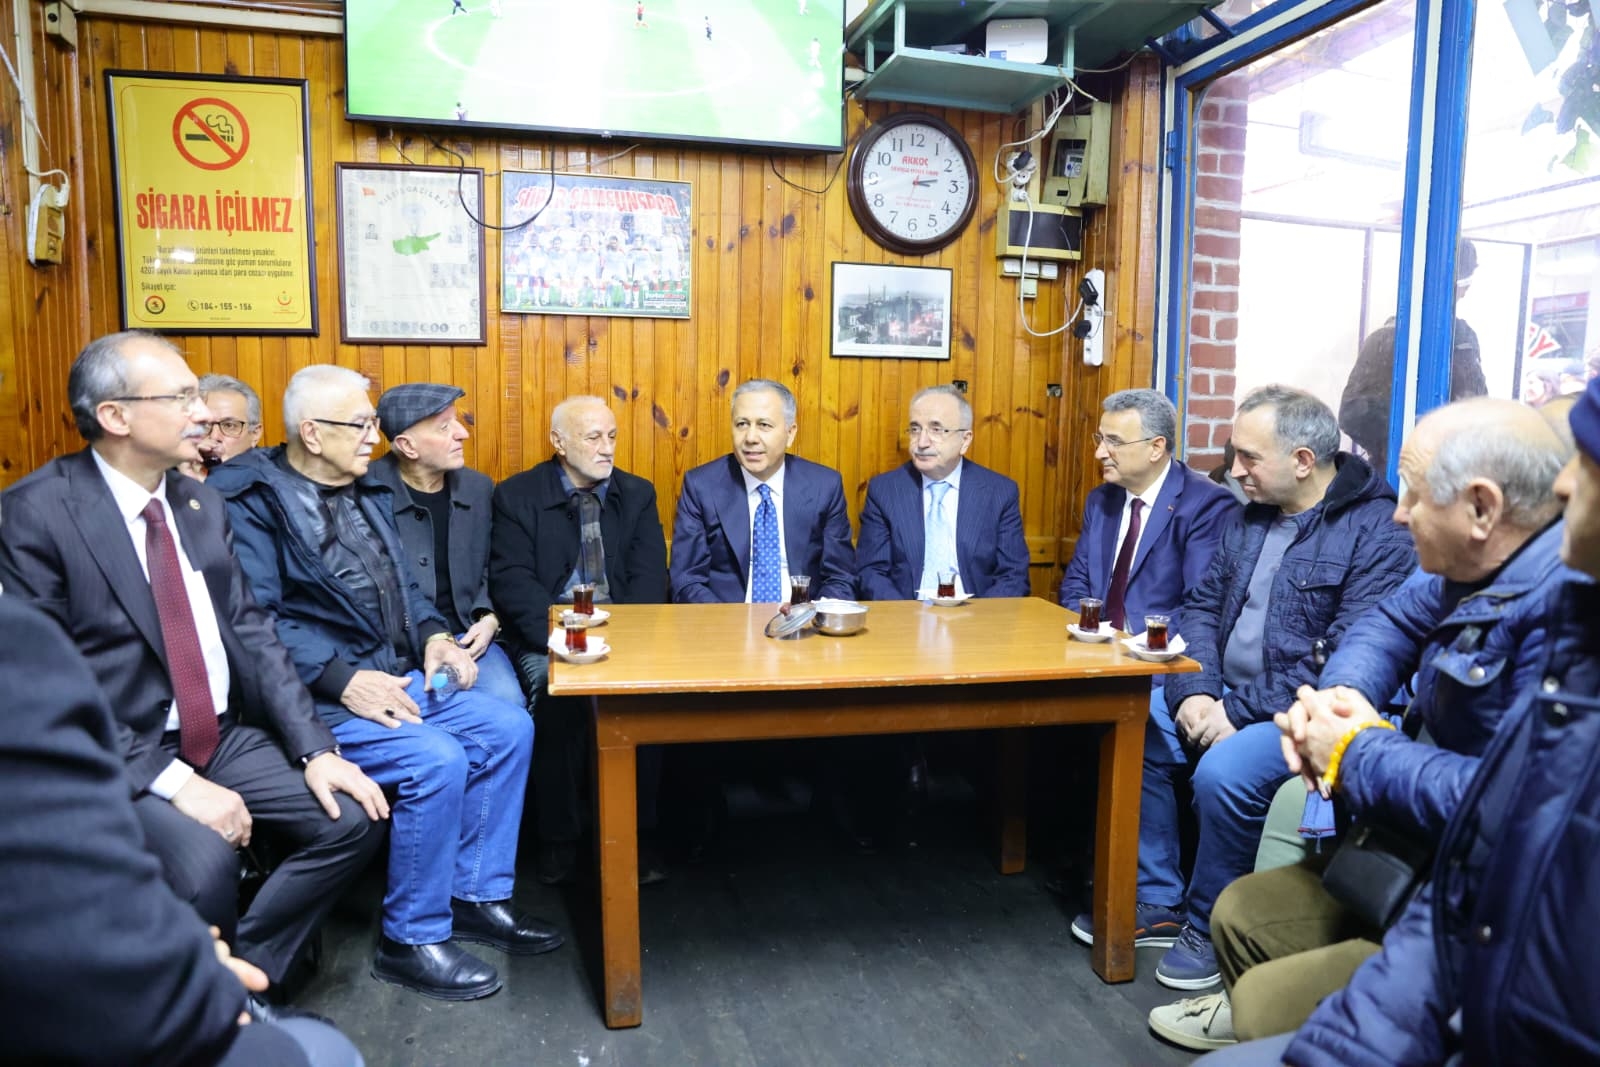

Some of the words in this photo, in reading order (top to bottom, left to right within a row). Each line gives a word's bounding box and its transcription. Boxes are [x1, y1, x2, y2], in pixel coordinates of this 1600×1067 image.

[892, 137, 903, 153] 11
[910, 133, 925, 148] 12
[934, 142, 939, 156] 1
[877, 151, 892, 166] 10
[943, 158, 953, 173] 2
[868, 171, 879, 186] 9
[948, 180, 959, 194] 3
[517, 186, 568, 211] SÜPR
[569, 186, 681, 218] SAMSUNSPOR
[873, 193, 884, 208] 8
[941, 200, 951, 215] 4
[135, 187, 212, 231] SİGARA
[215, 189, 294, 237] İÇİLMEZ
[889, 210, 899, 224] 7
[907, 218, 918, 232] 6
[927, 214, 938, 228] 5
[200, 302, 213, 311] 184
[220, 302, 233, 311] 155
[239, 302, 252, 311] 156
